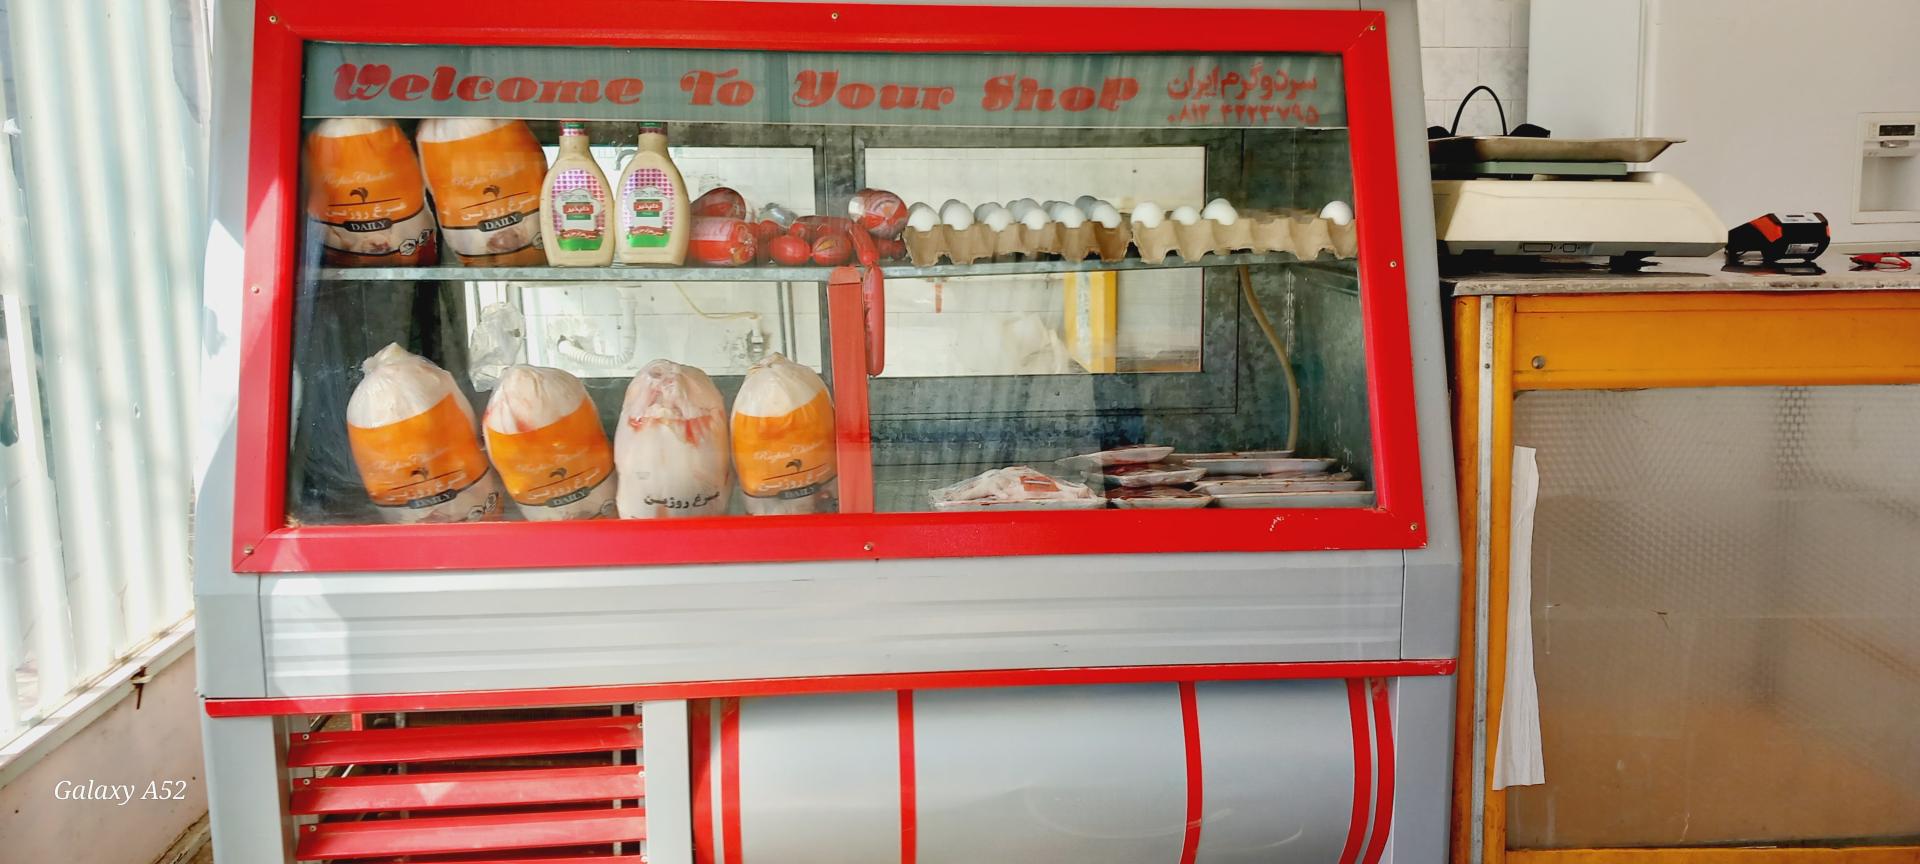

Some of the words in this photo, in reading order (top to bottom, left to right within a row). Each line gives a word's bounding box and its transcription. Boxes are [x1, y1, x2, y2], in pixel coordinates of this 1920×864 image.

[334, 64, 644, 105] Welcome
[680, 68, 755, 107] To
[792, 69, 955, 111] Your
[351, 220, 388, 231] DAILY
[485, 215, 518, 230] DAILY
[692, 491, 720, 507] مرغ
